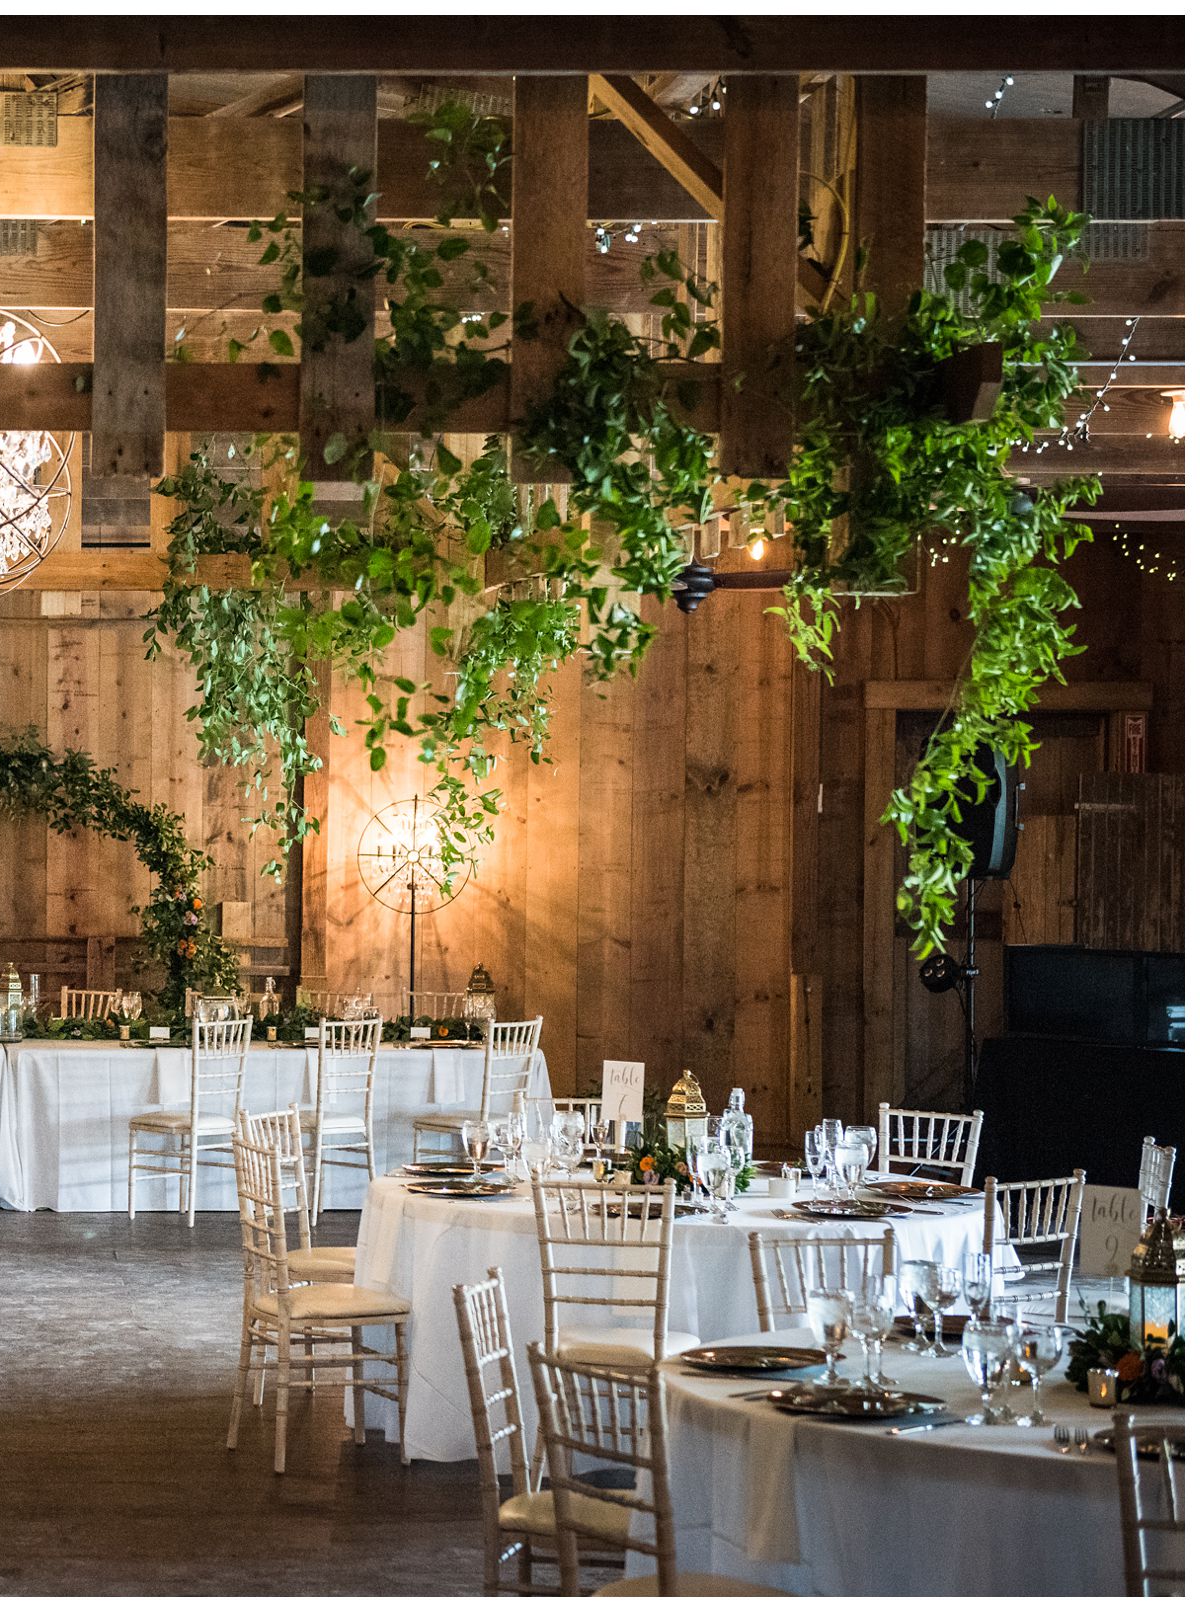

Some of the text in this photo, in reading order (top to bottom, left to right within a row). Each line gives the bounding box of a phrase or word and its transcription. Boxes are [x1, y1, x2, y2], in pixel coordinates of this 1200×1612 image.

[609, 1066, 641, 1087] table
[1091, 1194, 1136, 1222] table
[1105, 1233, 1119, 1263] 9
